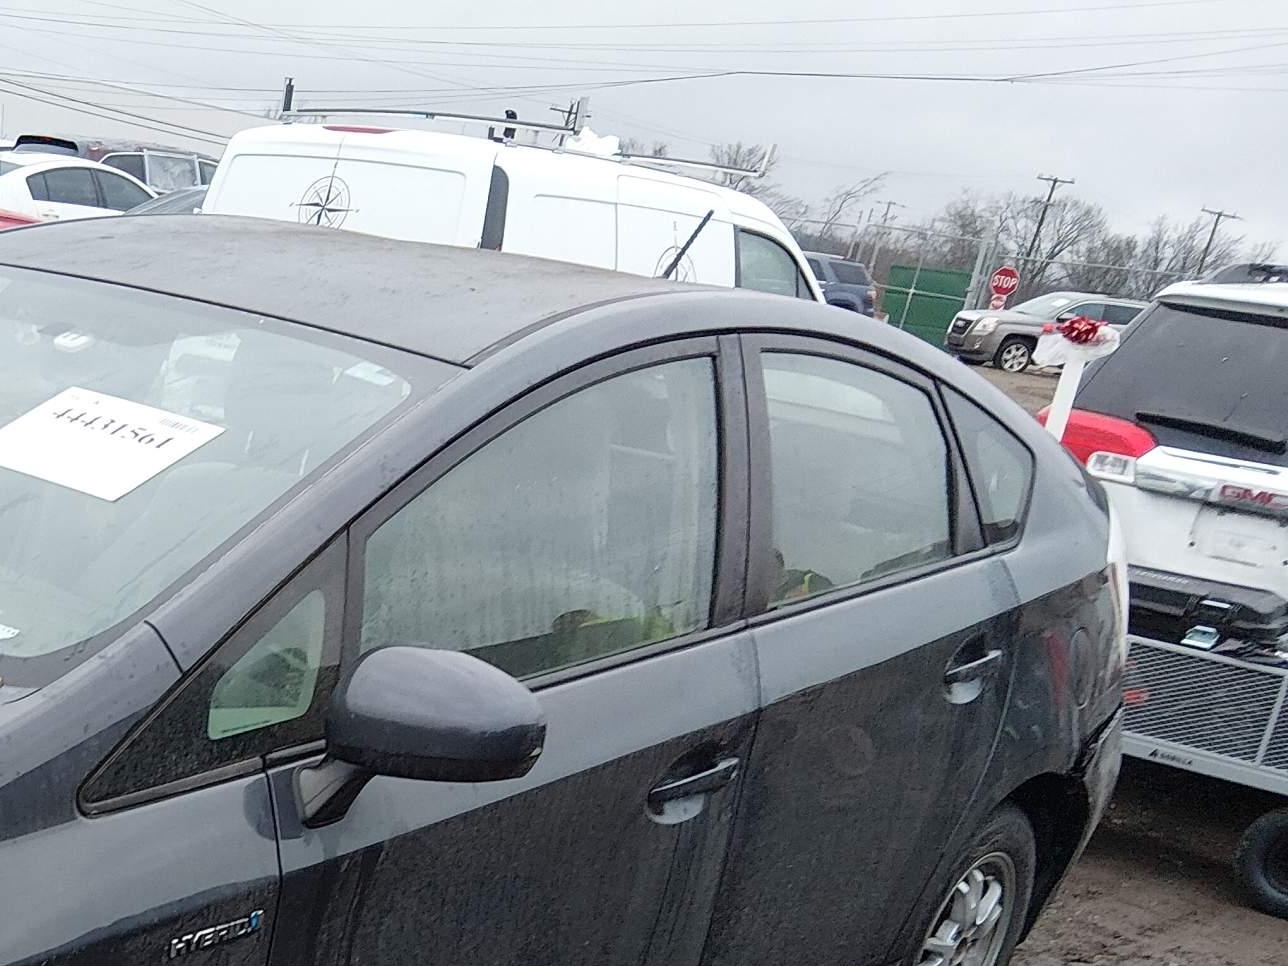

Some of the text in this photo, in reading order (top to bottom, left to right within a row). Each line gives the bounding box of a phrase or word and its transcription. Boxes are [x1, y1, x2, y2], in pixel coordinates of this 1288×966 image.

[992, 275, 1018, 288] STOP
[52, 408, 175, 448] 44431561
[1220, 484, 1288, 510] GMC
